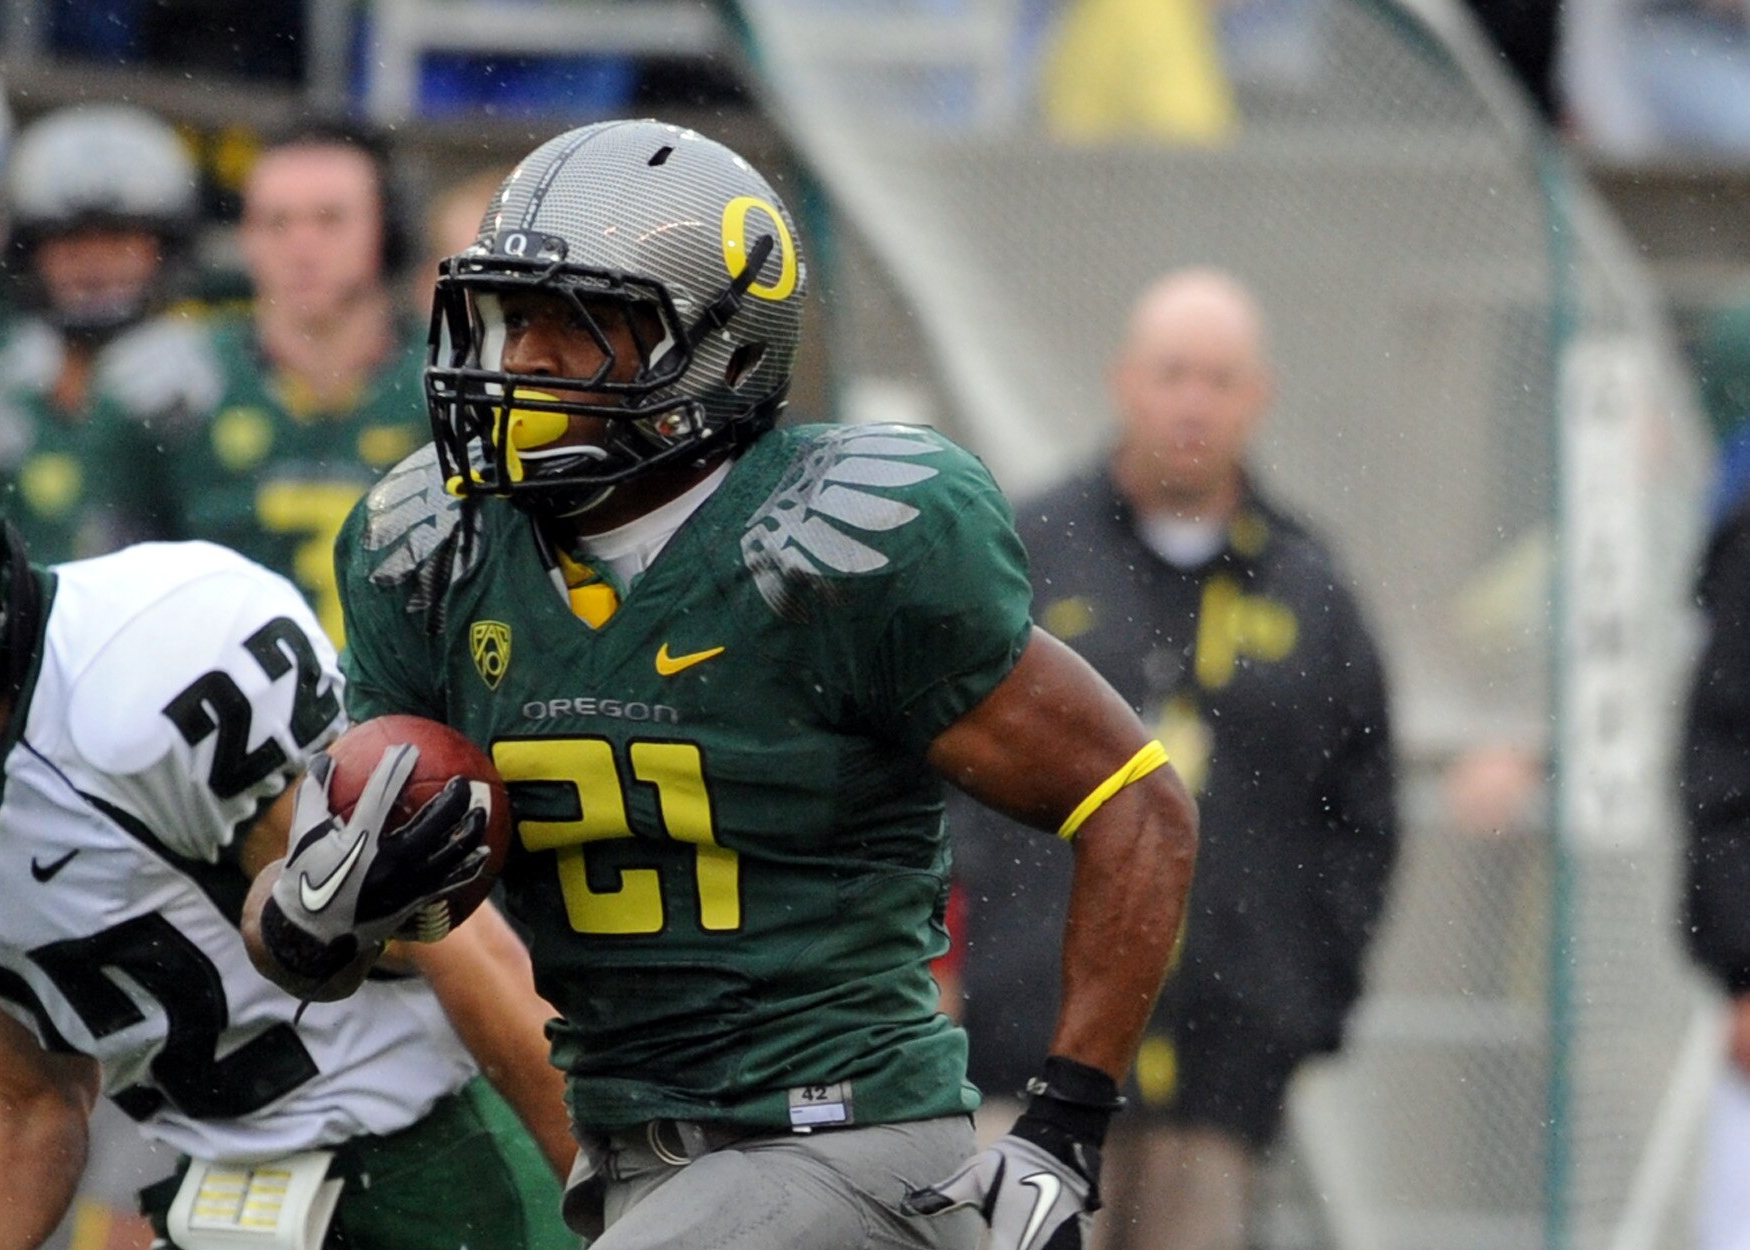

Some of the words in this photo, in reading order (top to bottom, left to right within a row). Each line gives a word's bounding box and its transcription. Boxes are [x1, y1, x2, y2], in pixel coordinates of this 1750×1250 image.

[720, 195, 796, 300] O
[482, 651, 502, 676] 10
[162, 616, 341, 798] 22
[522, 697, 679, 725] OREGON
[491, 737, 741, 935] 21
[801, 1084, 828, 1101] 42
